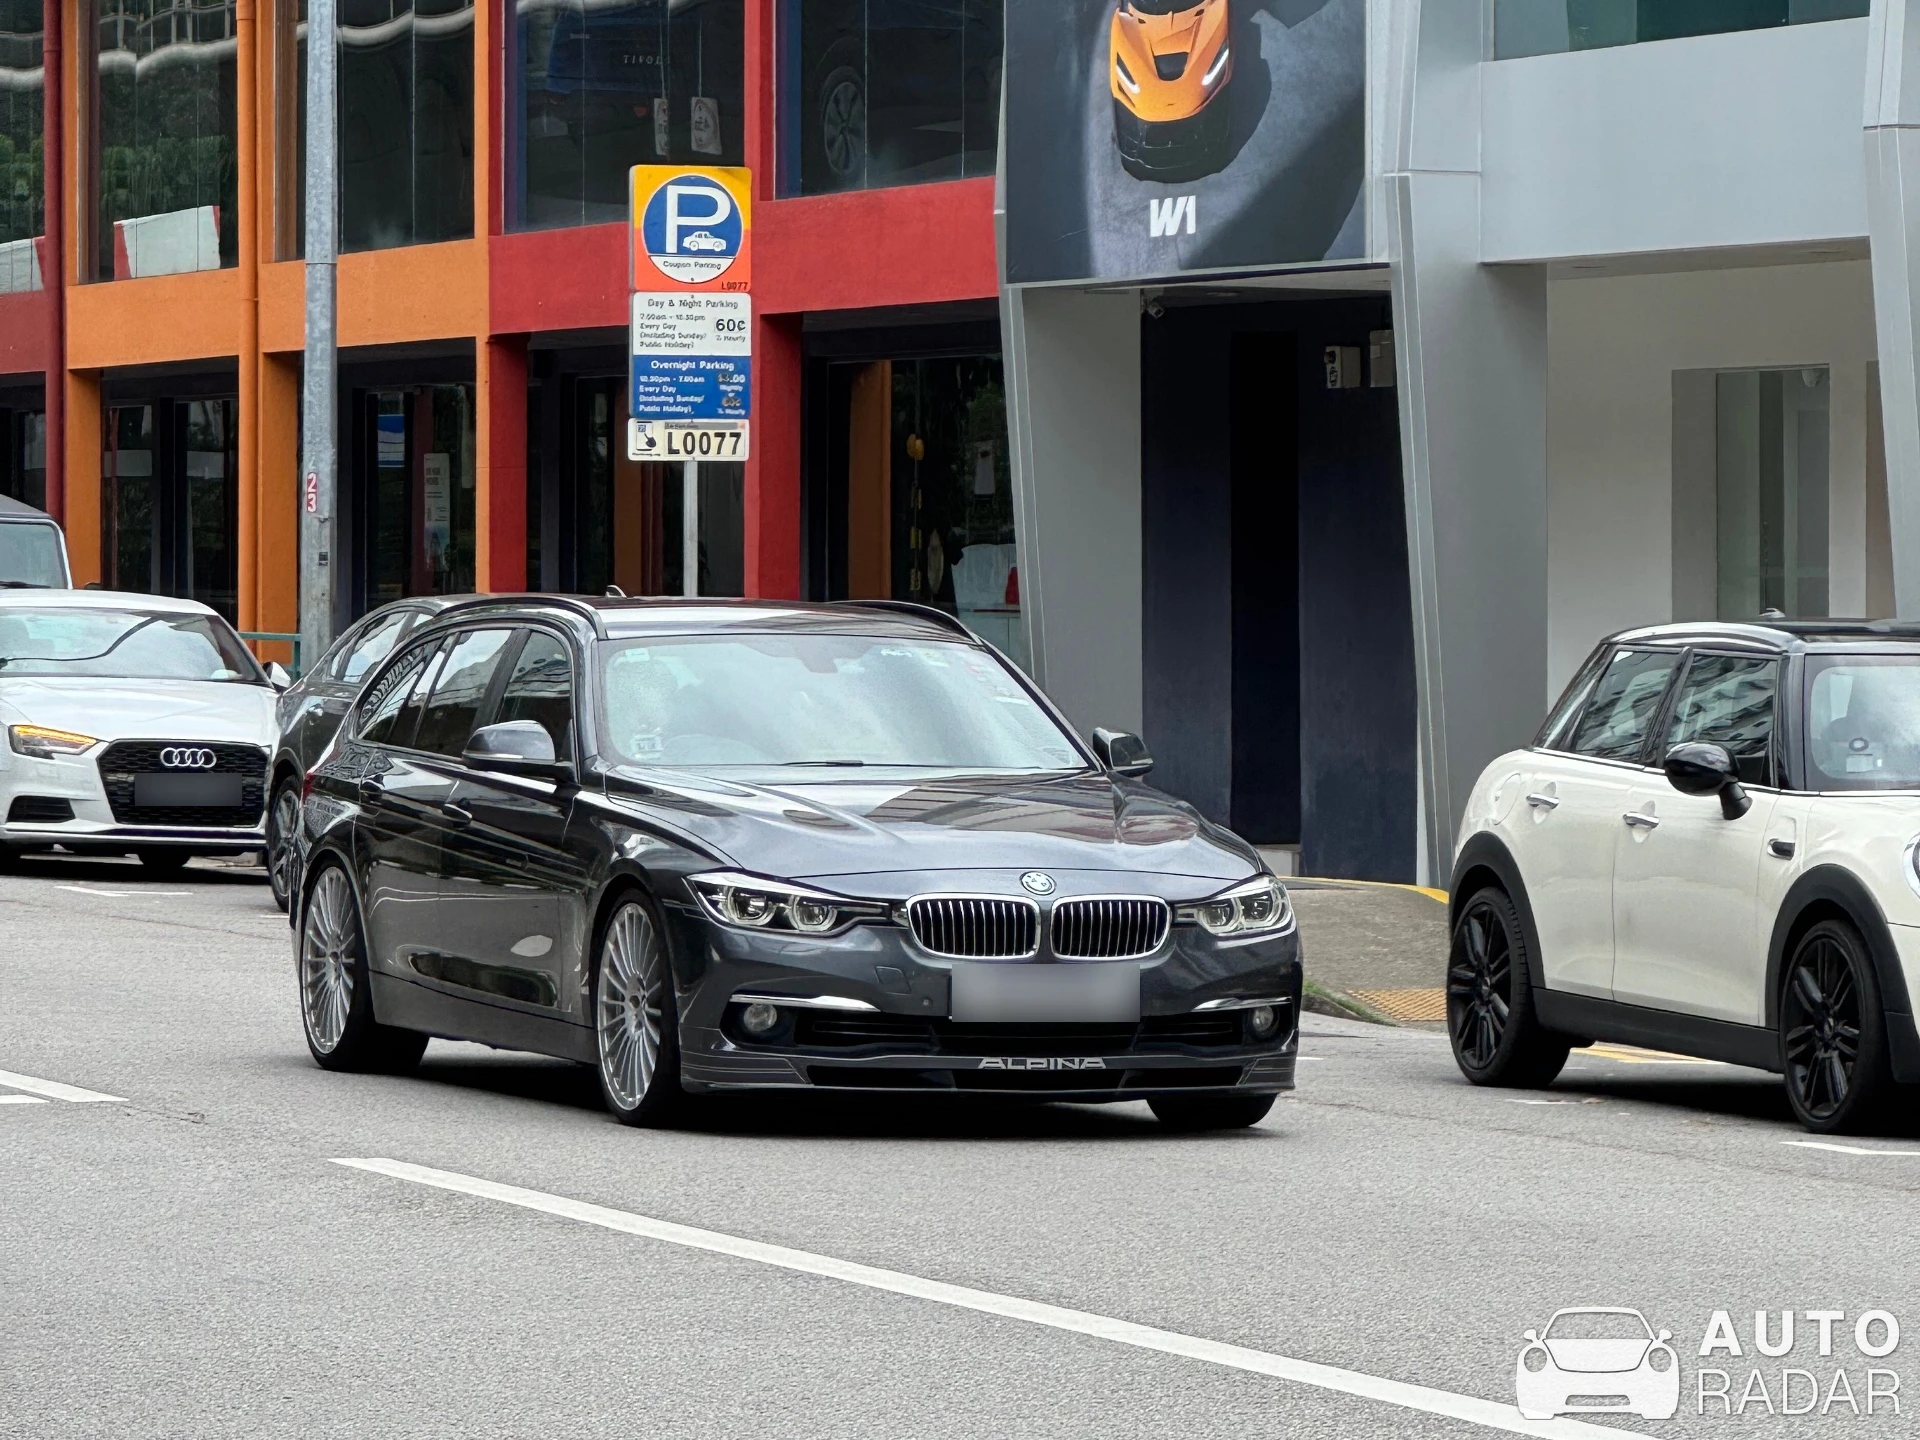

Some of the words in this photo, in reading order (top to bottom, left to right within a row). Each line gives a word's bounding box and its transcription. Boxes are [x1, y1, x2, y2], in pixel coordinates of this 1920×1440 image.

[666, 185, 731, 253] P
[663, 260, 691, 269] Coupon
[694, 261, 721, 270] Parking
[721, 282, 748, 291] L0077
[647, 299, 664, 309] Day
[668, 299, 675, 307] &
[679, 299, 702, 309] Night
[706, 300, 738, 310] Parking
[640, 323, 660, 331] Every
[662, 323, 676, 331] Day
[651, 360, 695, 371] Overnight
[700, 361, 735, 371] Parking
[639, 385, 660, 393] Every
[662, 385, 677, 393] Day
[639, 404, 661, 412] Public
[667, 432, 742, 455] L0077
[978, 1057, 1107, 1070] ALPINA
